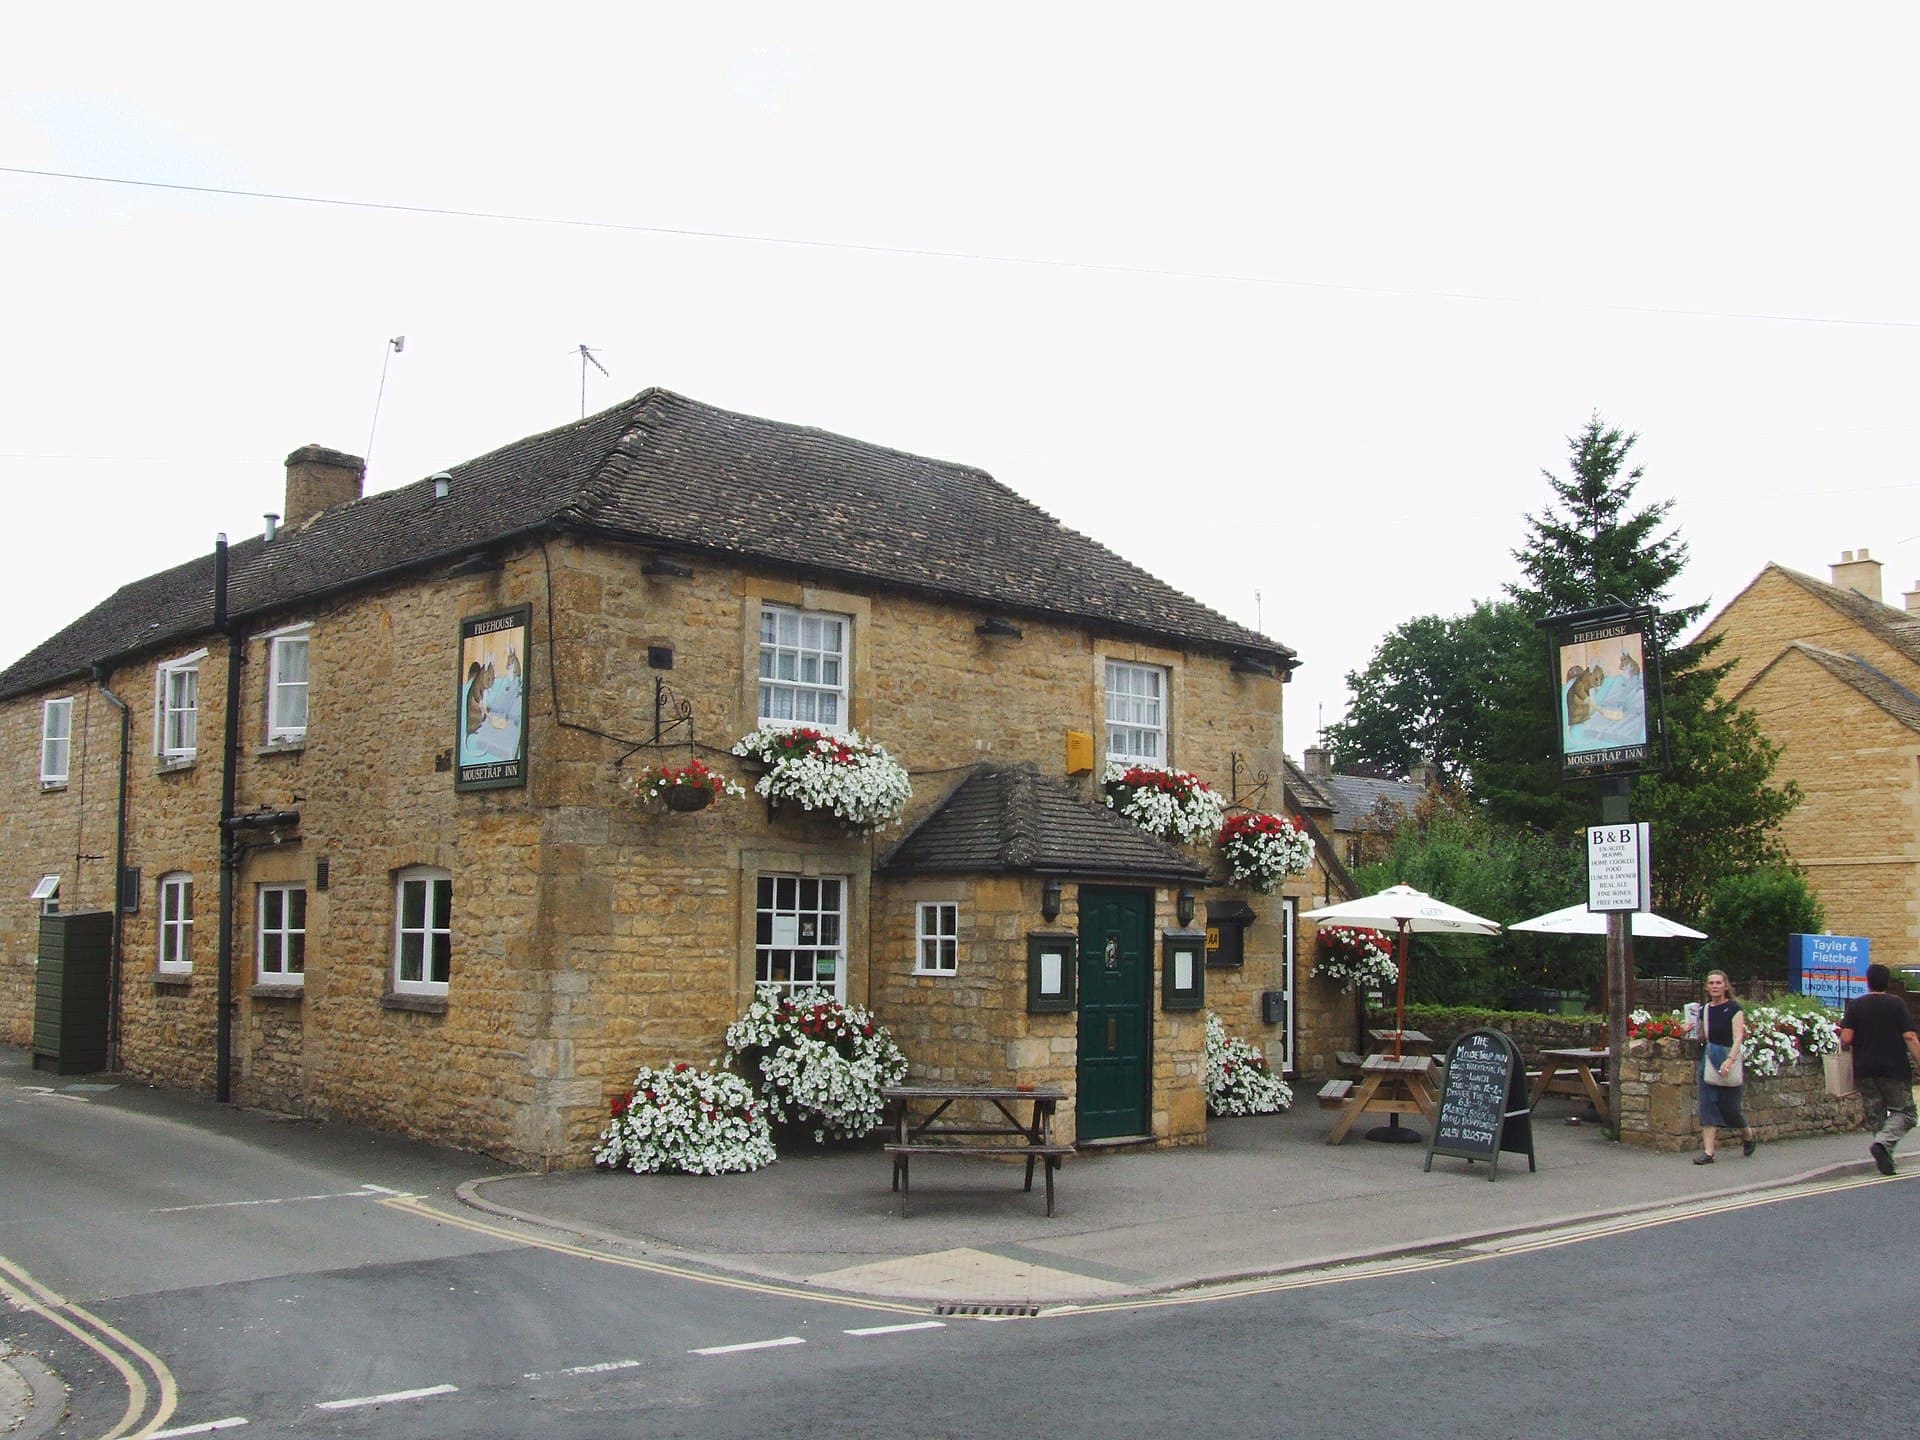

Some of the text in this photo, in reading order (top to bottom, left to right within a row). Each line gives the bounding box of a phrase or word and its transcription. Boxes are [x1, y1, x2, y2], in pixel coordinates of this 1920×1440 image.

[474, 616, 514, 635] FREEHOUSE
[1573, 625, 1627, 643] FREEHOUSE
[1567, 747, 1643, 766] MOUSETRAP INN
[462, 763, 518, 781] MOUSETRAP INN
[1593, 829, 1631, 845] B & B
[1812, 939, 1858, 952] Tayler &
[1812, 952, 1858, 964] Fletcher
[1804, 983, 1865, 994] UNDER OFFER
[1472, 1035, 1490, 1048] THE
